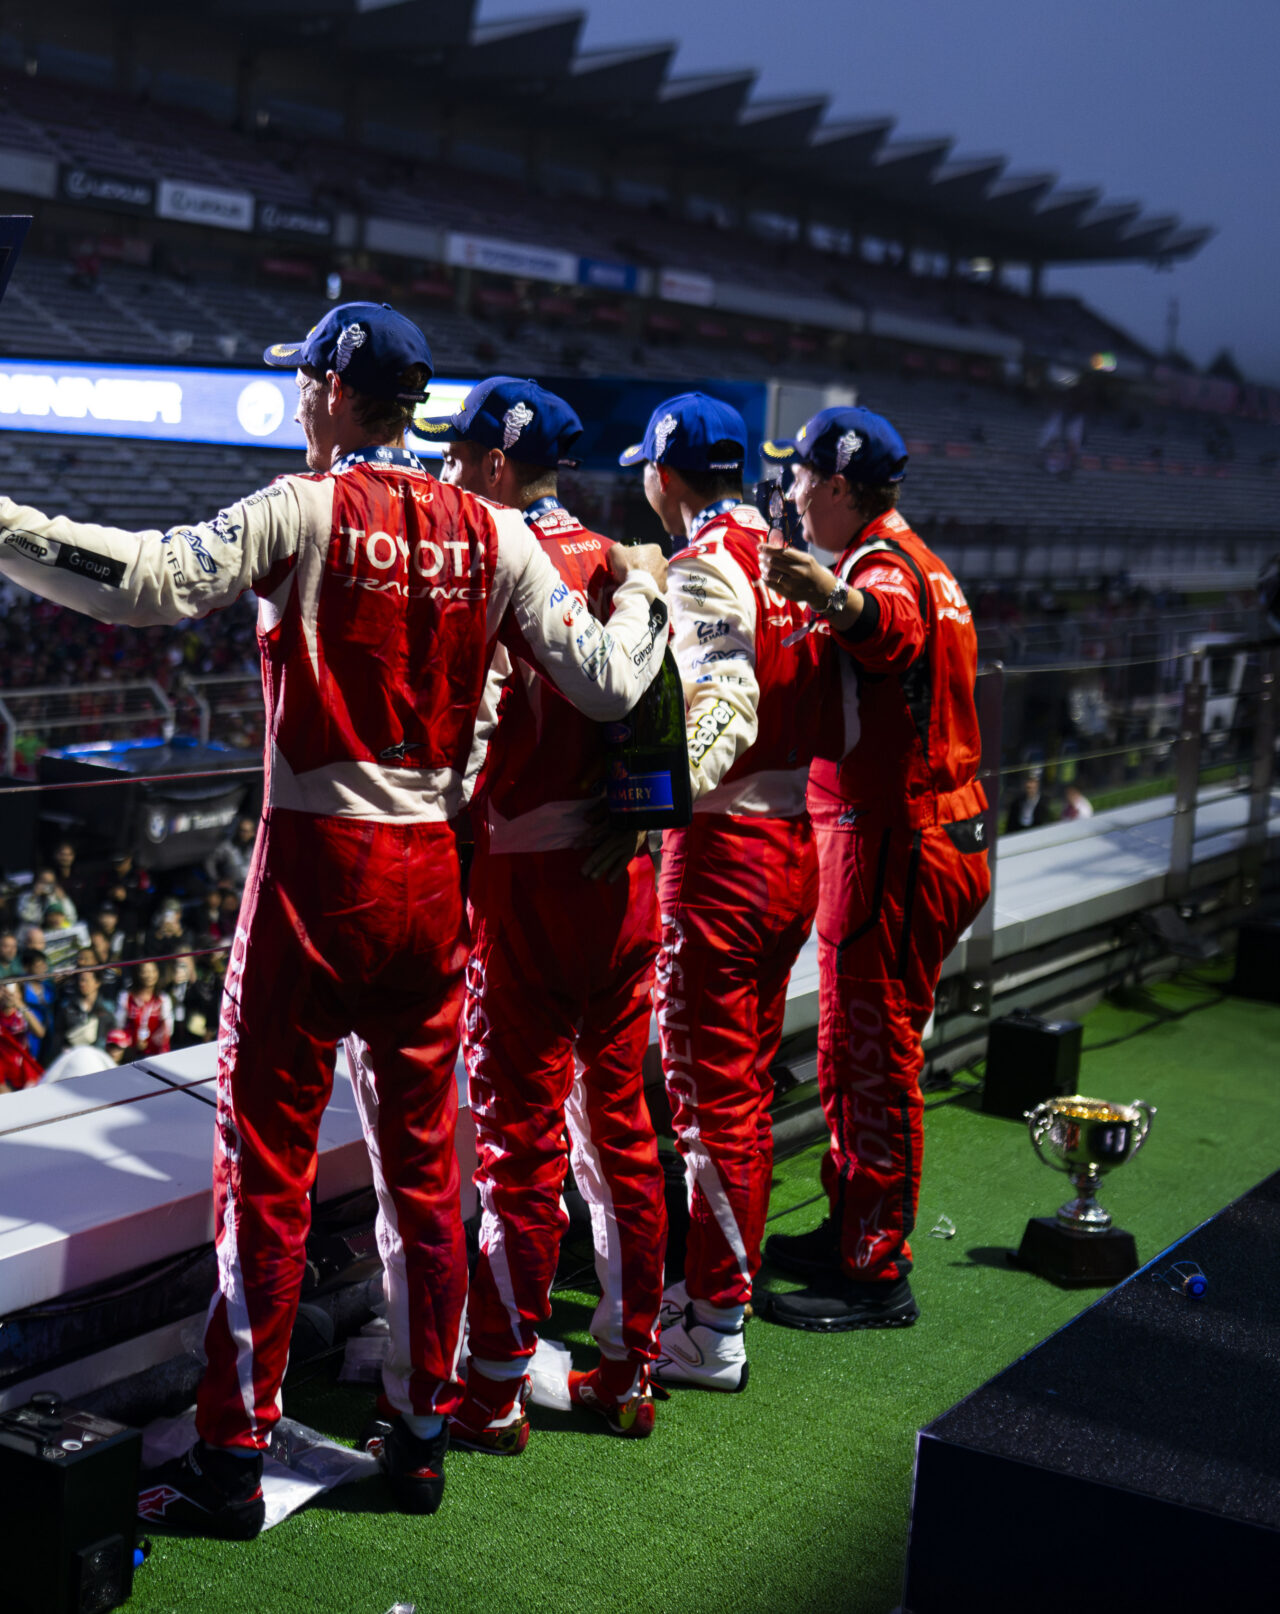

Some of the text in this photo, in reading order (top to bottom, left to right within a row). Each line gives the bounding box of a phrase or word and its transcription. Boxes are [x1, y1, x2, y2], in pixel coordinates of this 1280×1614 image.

[4, 533, 112, 578] Giltrap Group
[560, 539, 602, 556] DENSO
[655, 914, 699, 1107] DENSO
[849, 998, 893, 1168] DENSO
